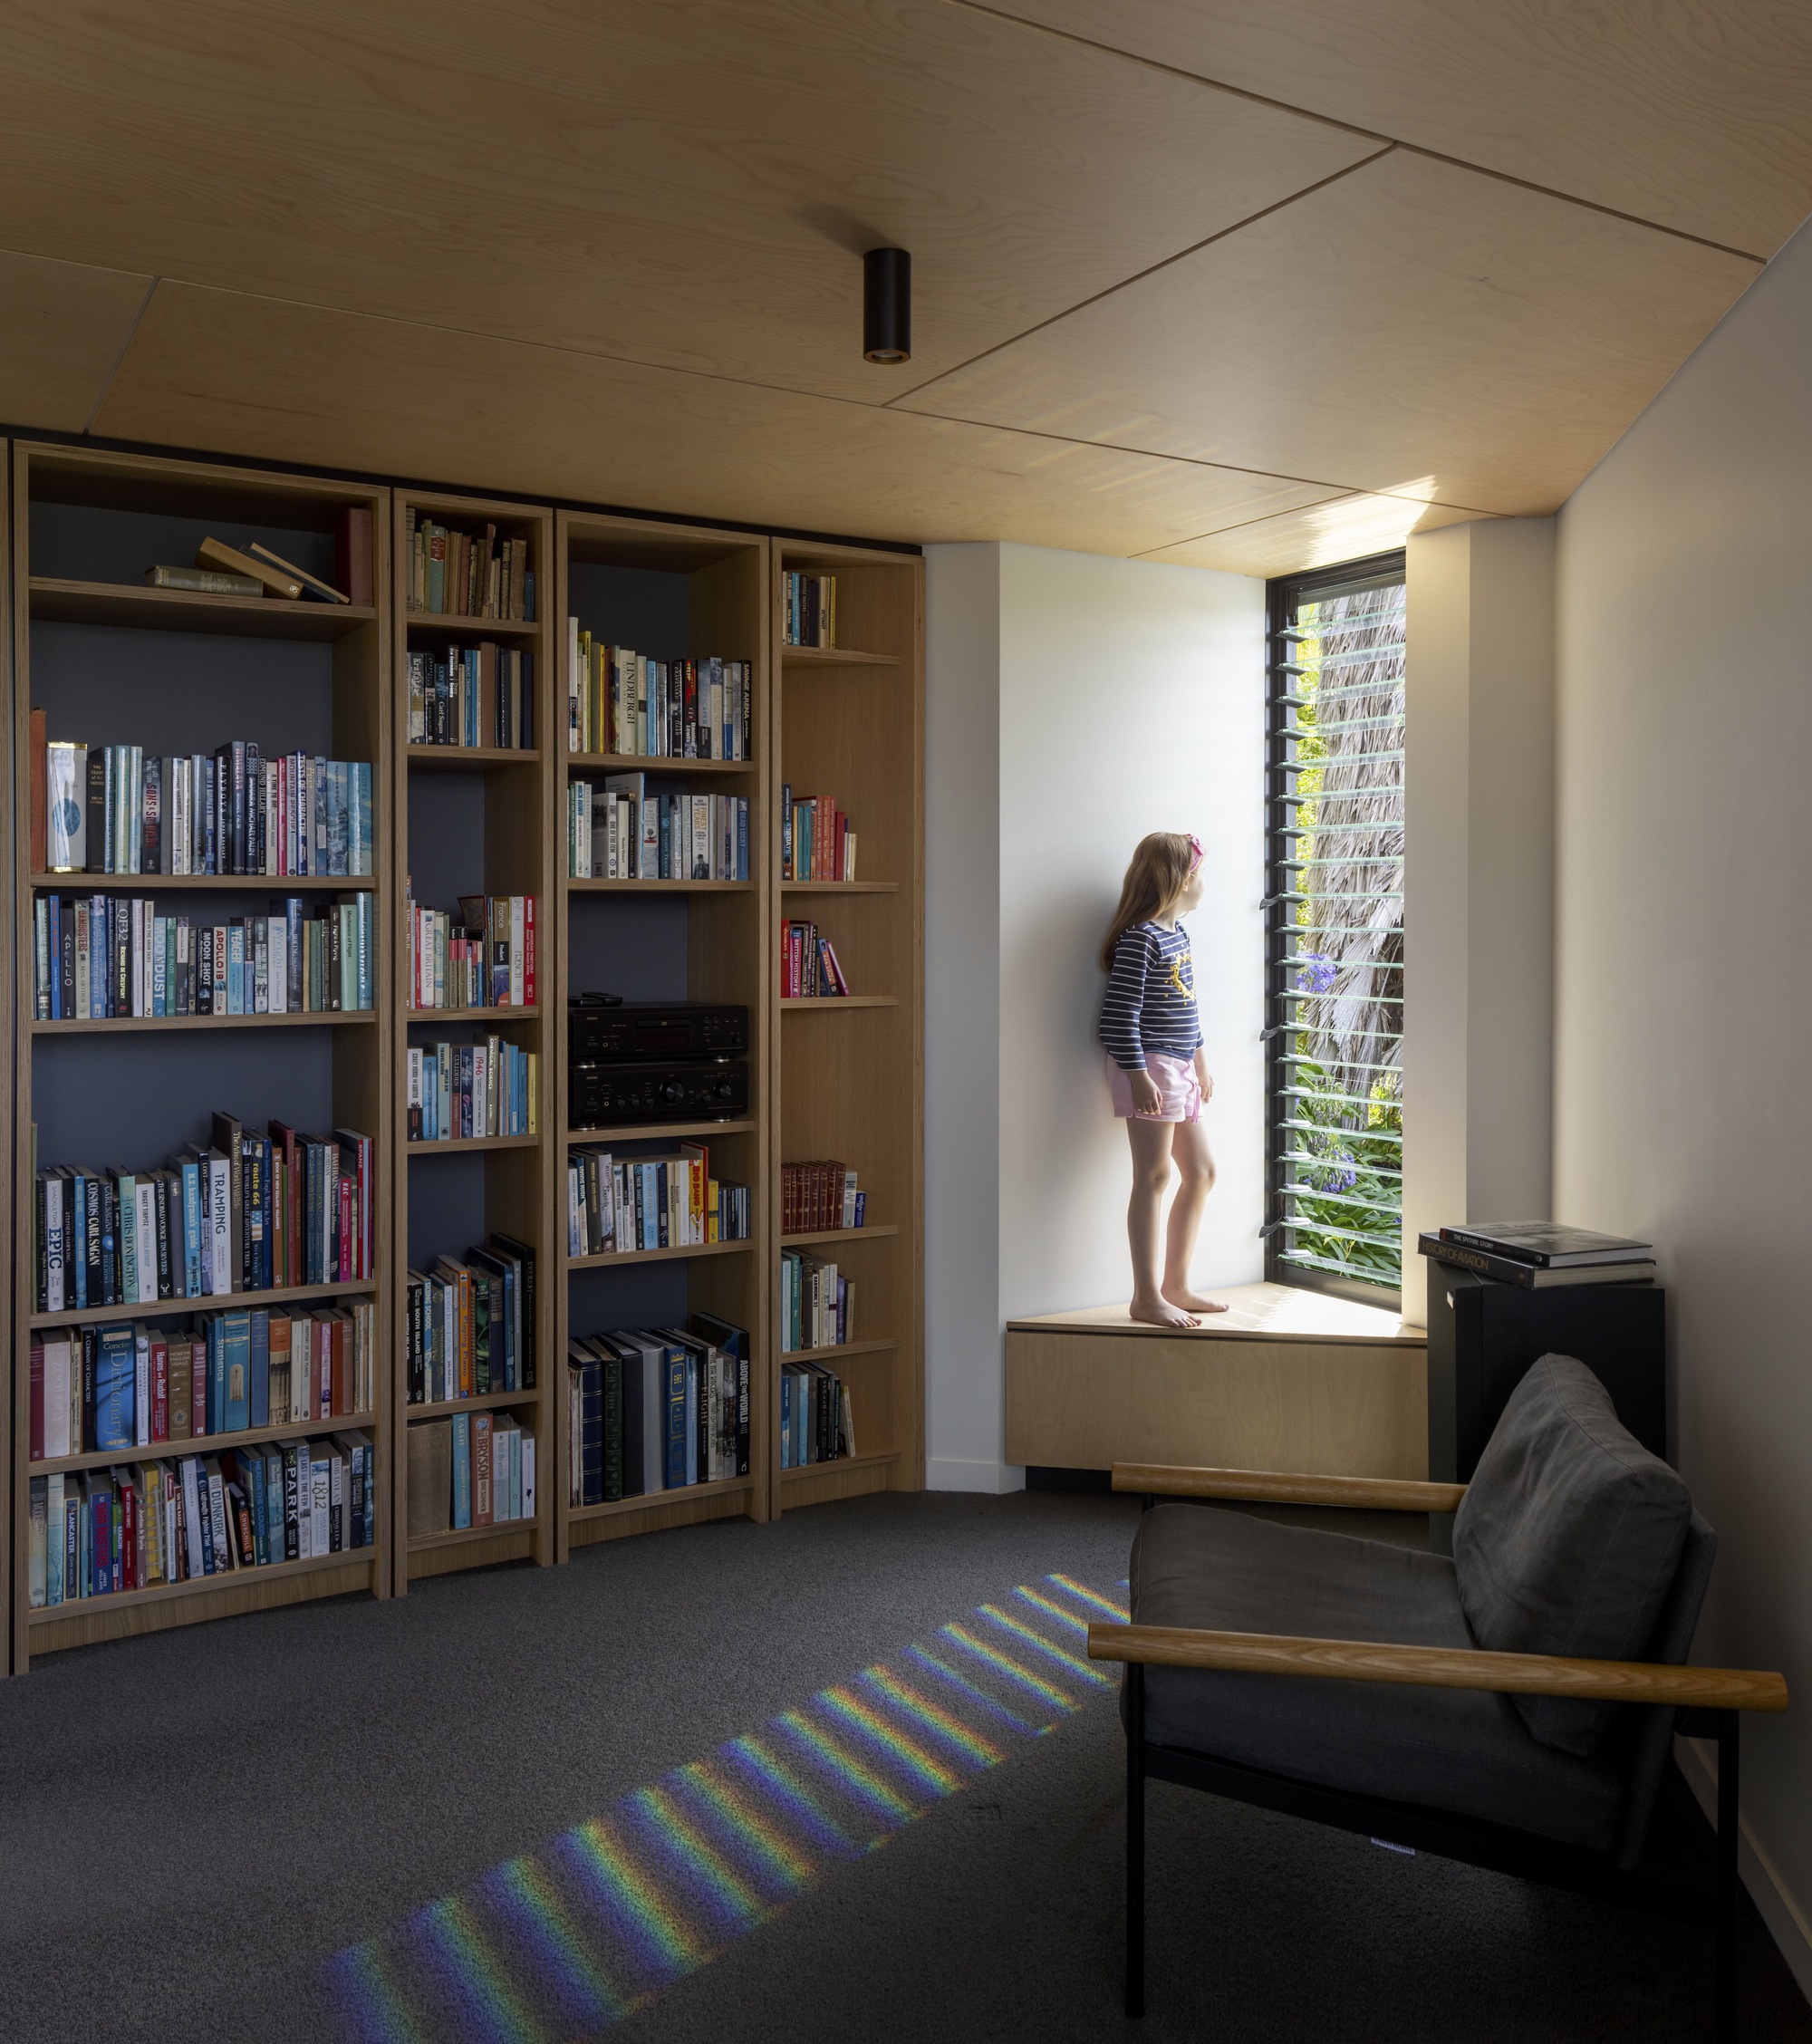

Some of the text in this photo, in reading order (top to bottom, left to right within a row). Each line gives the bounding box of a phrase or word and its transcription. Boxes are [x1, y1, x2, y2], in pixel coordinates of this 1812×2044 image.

[79, 911, 87, 951] DAMBUSTERS
[117, 909, 128, 940] QF32
[64, 934, 72, 986] APOLLO
[154, 922, 165, 1000] MOONDUST
[231, 930, 242, 963] YEAGER
[275, 931, 283, 969] Wright
[217, 971, 223, 979] 13
[476, 1056, 484, 1075] 1946
[215, 1172, 225, 1234] TRAMPING
[253, 1192, 260, 1205] 66
[88, 1182, 100, 1265] COSMOS CARL SAGAN
[1462, 1236, 1479, 1246] SPITFIRE
[1478, 1239, 1493, 1249] STORY
[49, 1228, 62, 1269] EPIC
[124, 1206, 134, 1287] CHRIS BONINGTON
[1422, 1240, 1489, 1269] HISTORY OF AVIATION
[740, 1360, 748, 1386] ABOVE
[102, 1351, 127, 1437] Dictionary
[740, 1395, 748, 1422] WORLD
[255, 1461, 263, 1480] HEAD
[477, 1438, 488, 1480] BRYSON
[256, 1482, 263, 1490] IN
[287, 1467, 297, 1522] PARK
[313, 1480, 328, 1509] 1812
[200, 1491, 211, 1547] Luftwaffe Fighter Pilot
[211, 1490, 224, 1538] DUNKIRK
[242, 1513, 250, 1549] CHURCHILL
[96, 1502, 109, 1567] DAM BUSTERS
